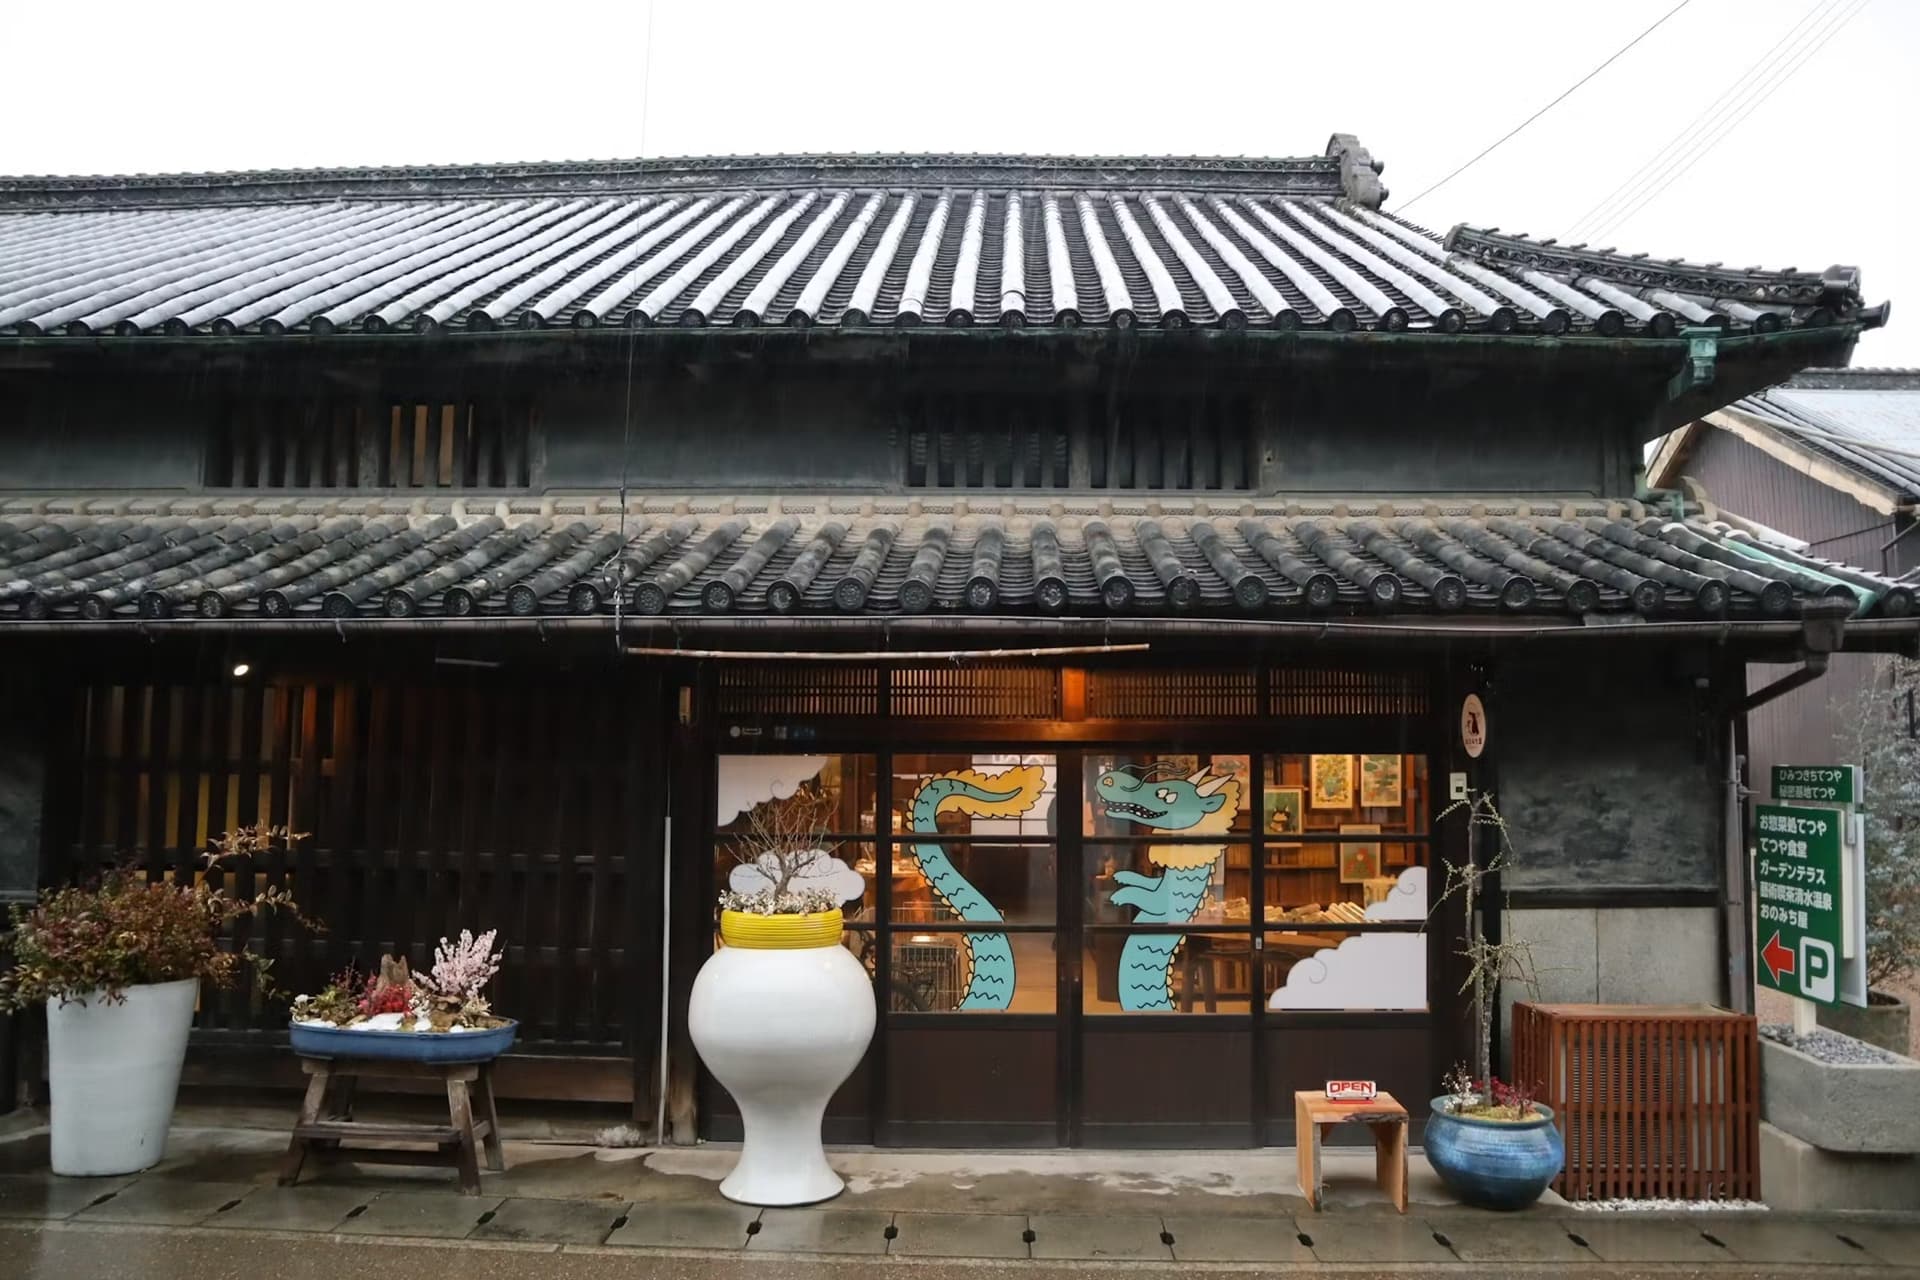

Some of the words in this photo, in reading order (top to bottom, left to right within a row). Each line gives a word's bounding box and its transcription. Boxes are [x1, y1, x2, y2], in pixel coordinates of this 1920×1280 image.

[1780, 769, 1842, 782] ひみつきちてつや
[1760, 838, 1807, 858] てつや食堂
[1760, 860, 1826, 885] ガーデンテラス
[1804, 942, 1829, 990] P
[1330, 1082, 1372, 1093] OPEN
